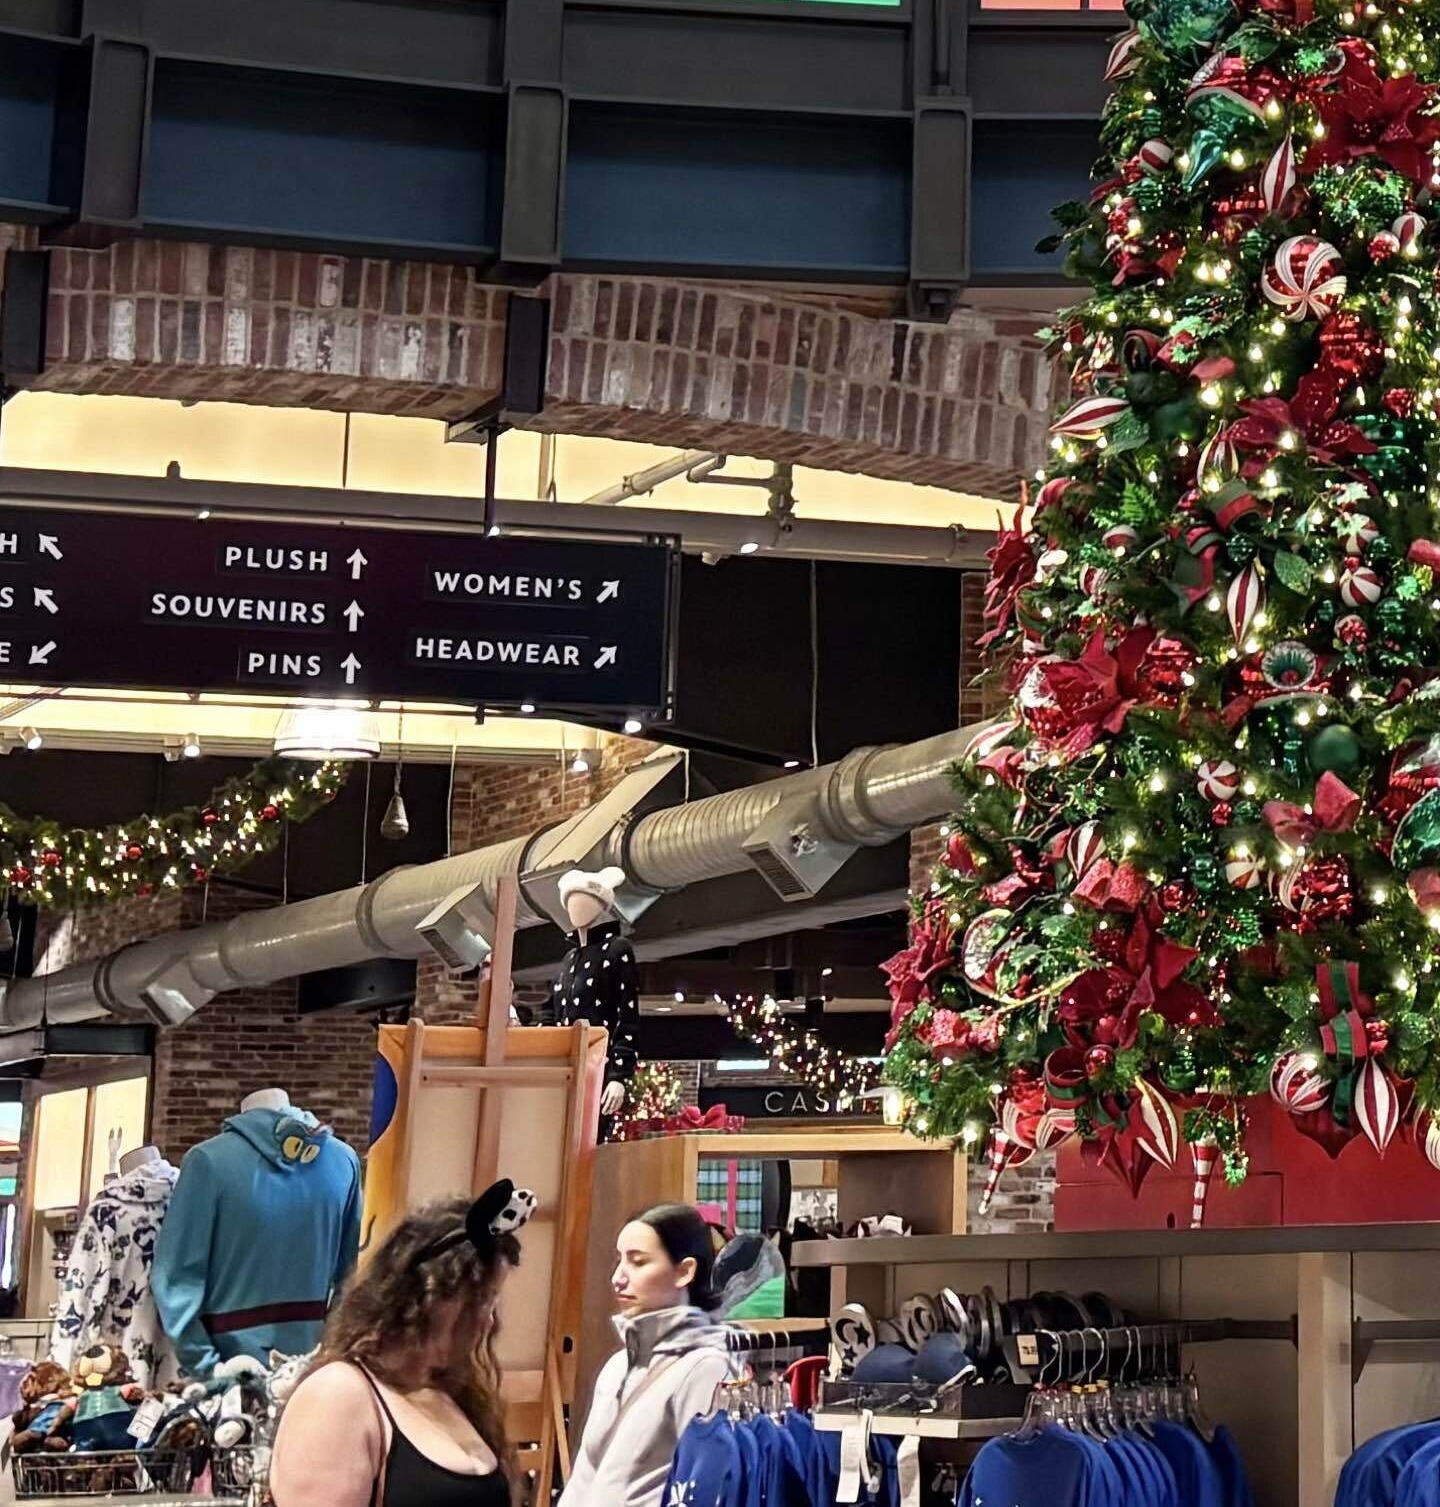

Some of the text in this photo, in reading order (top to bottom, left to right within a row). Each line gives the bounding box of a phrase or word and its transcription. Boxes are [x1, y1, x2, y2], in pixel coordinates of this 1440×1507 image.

[225, 546, 328, 572] PLUSH
[434, 571, 582, 600] WOMEN'S
[151, 593, 326, 624] SOUVENIRS
[248, 652, 321, 677] PINS
[415, 637, 580, 666] HEADWEAR
